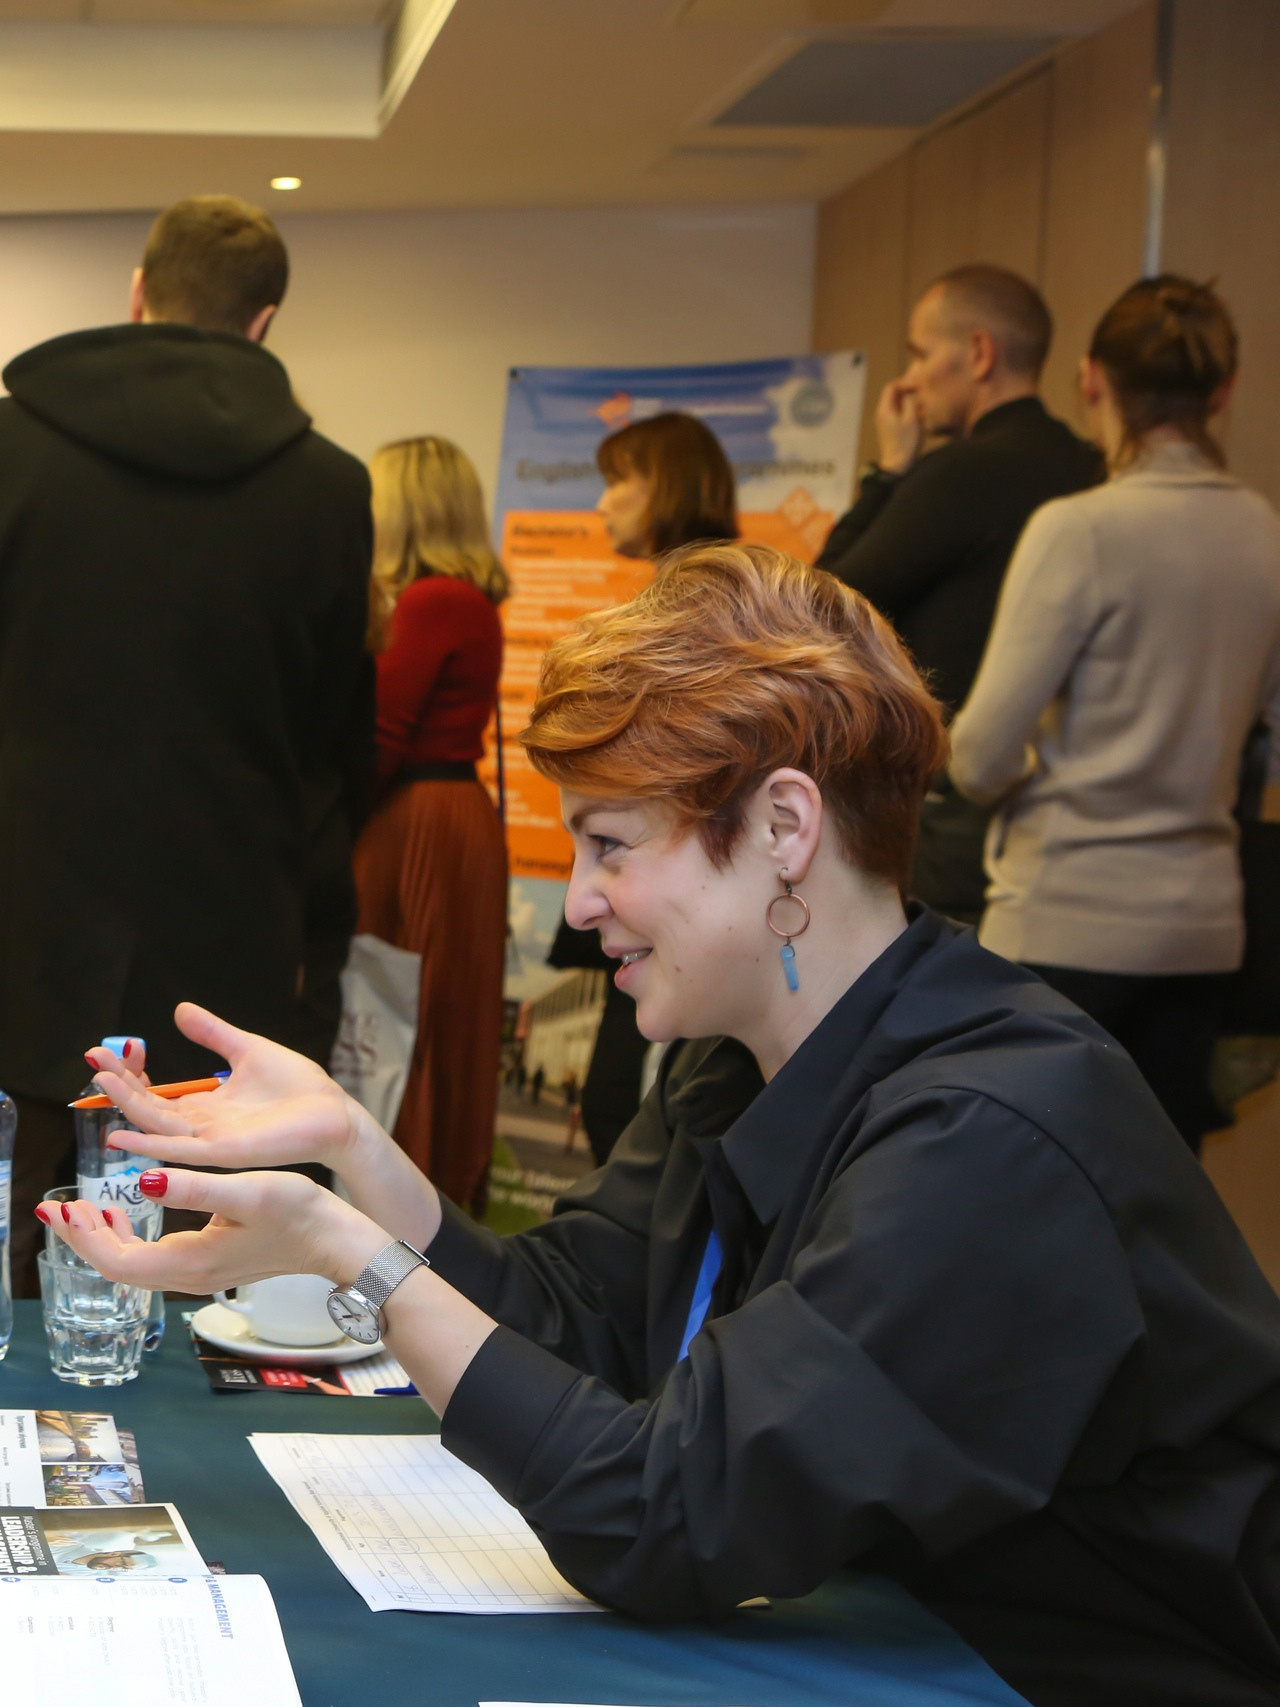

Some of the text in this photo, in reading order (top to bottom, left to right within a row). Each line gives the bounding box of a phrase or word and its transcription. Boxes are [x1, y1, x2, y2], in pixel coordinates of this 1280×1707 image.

[1, 1516, 34, 1565] LEADERSHIP
[26, 1535, 45, 1560] programme
[208, 1584, 234, 1639] MANAGEMENT
